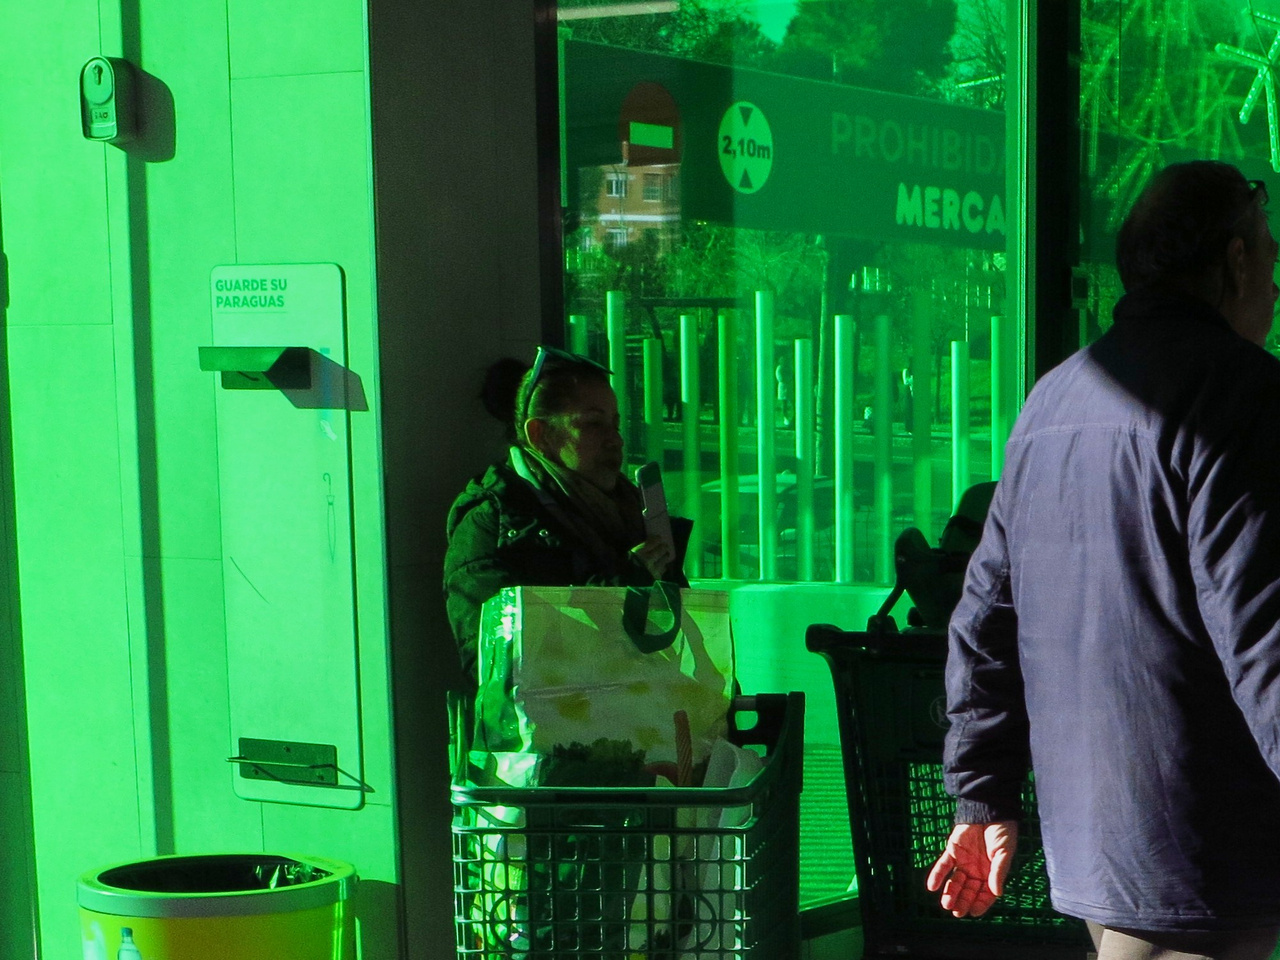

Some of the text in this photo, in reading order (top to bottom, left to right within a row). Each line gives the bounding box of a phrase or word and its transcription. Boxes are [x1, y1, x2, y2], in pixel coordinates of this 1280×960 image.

[722, 135, 771, 160] 2,10m
[830, 111, 1006, 175] PROHIBID
[215, 279, 288, 292] GUARDE SU
[216, 295, 285, 308] PARAGUAS
